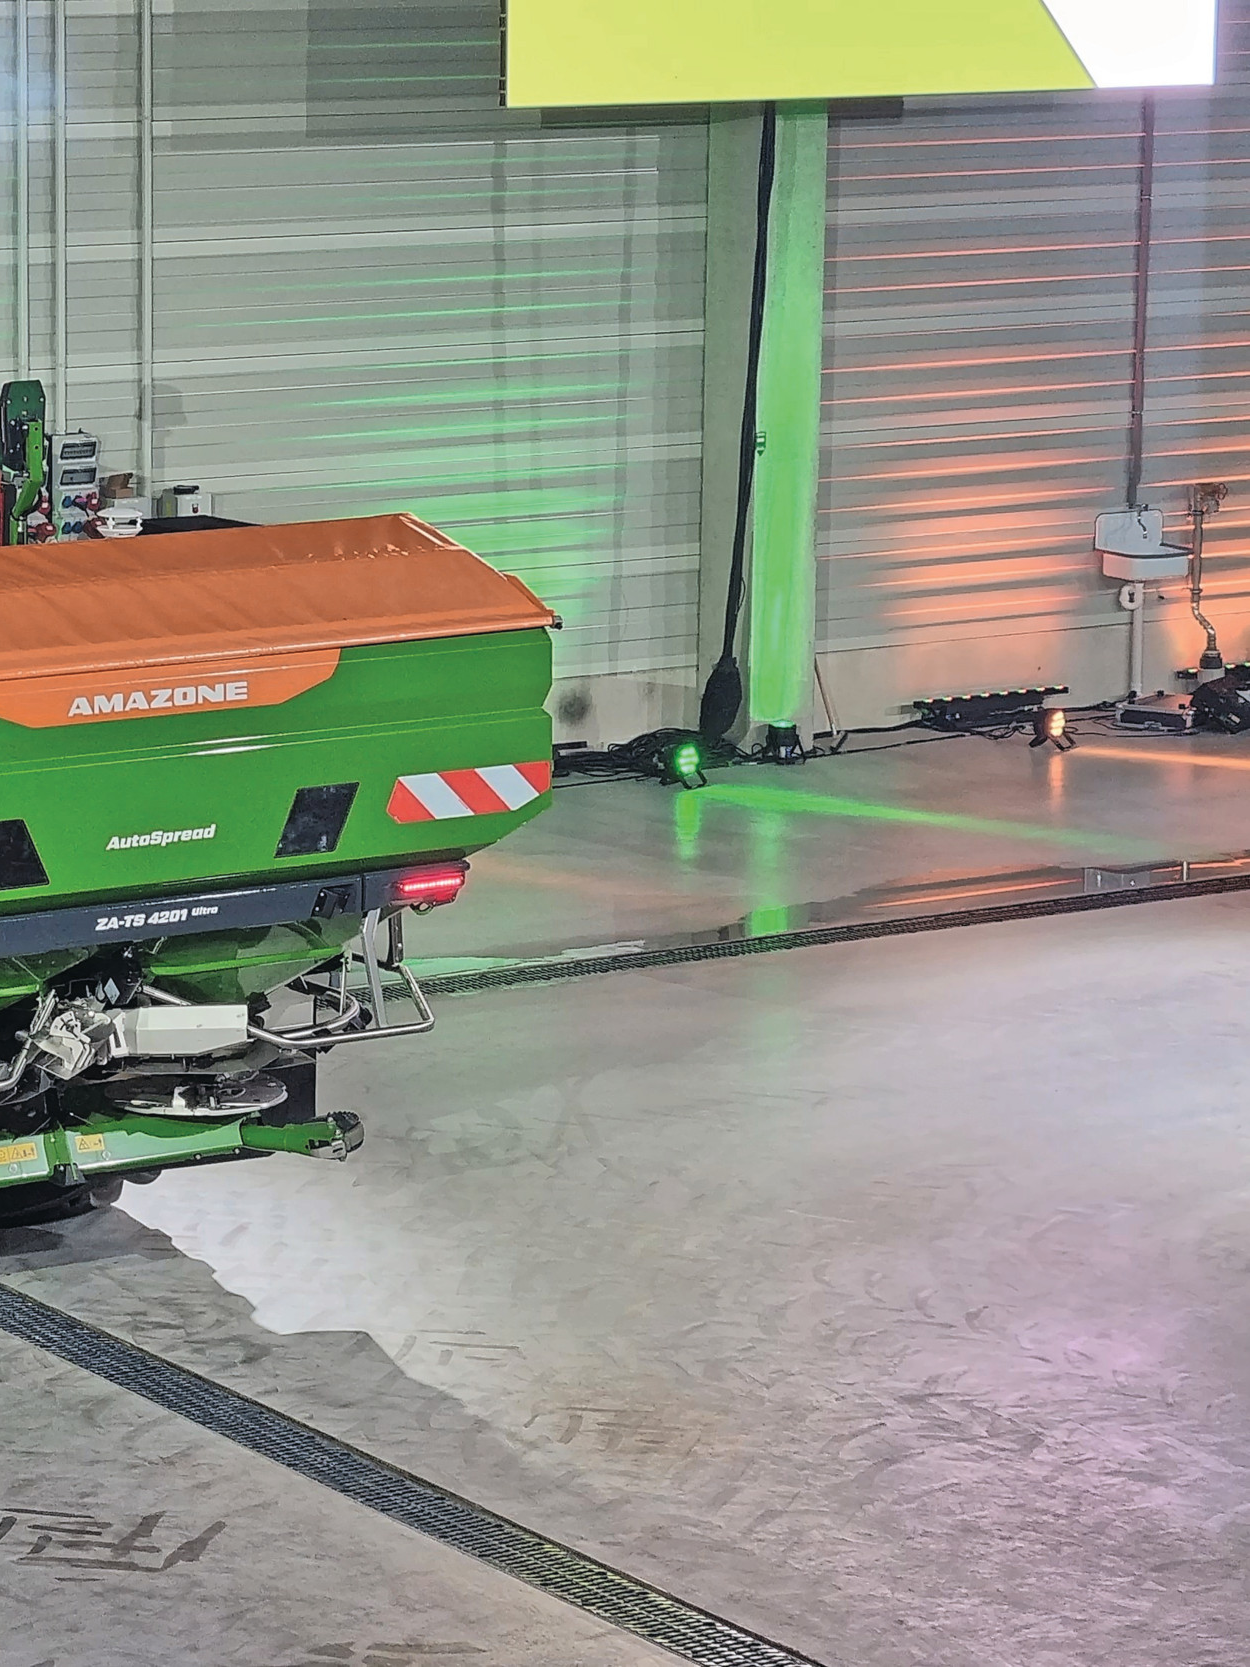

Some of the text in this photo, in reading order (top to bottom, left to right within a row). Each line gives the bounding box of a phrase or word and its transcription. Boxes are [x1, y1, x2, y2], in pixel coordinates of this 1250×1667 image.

[68, 681, 248, 717] AMAZONE
[105, 823, 217, 851] AutoSpread
[94, 906, 219, 931] ZA-TS 4201 Ultra
